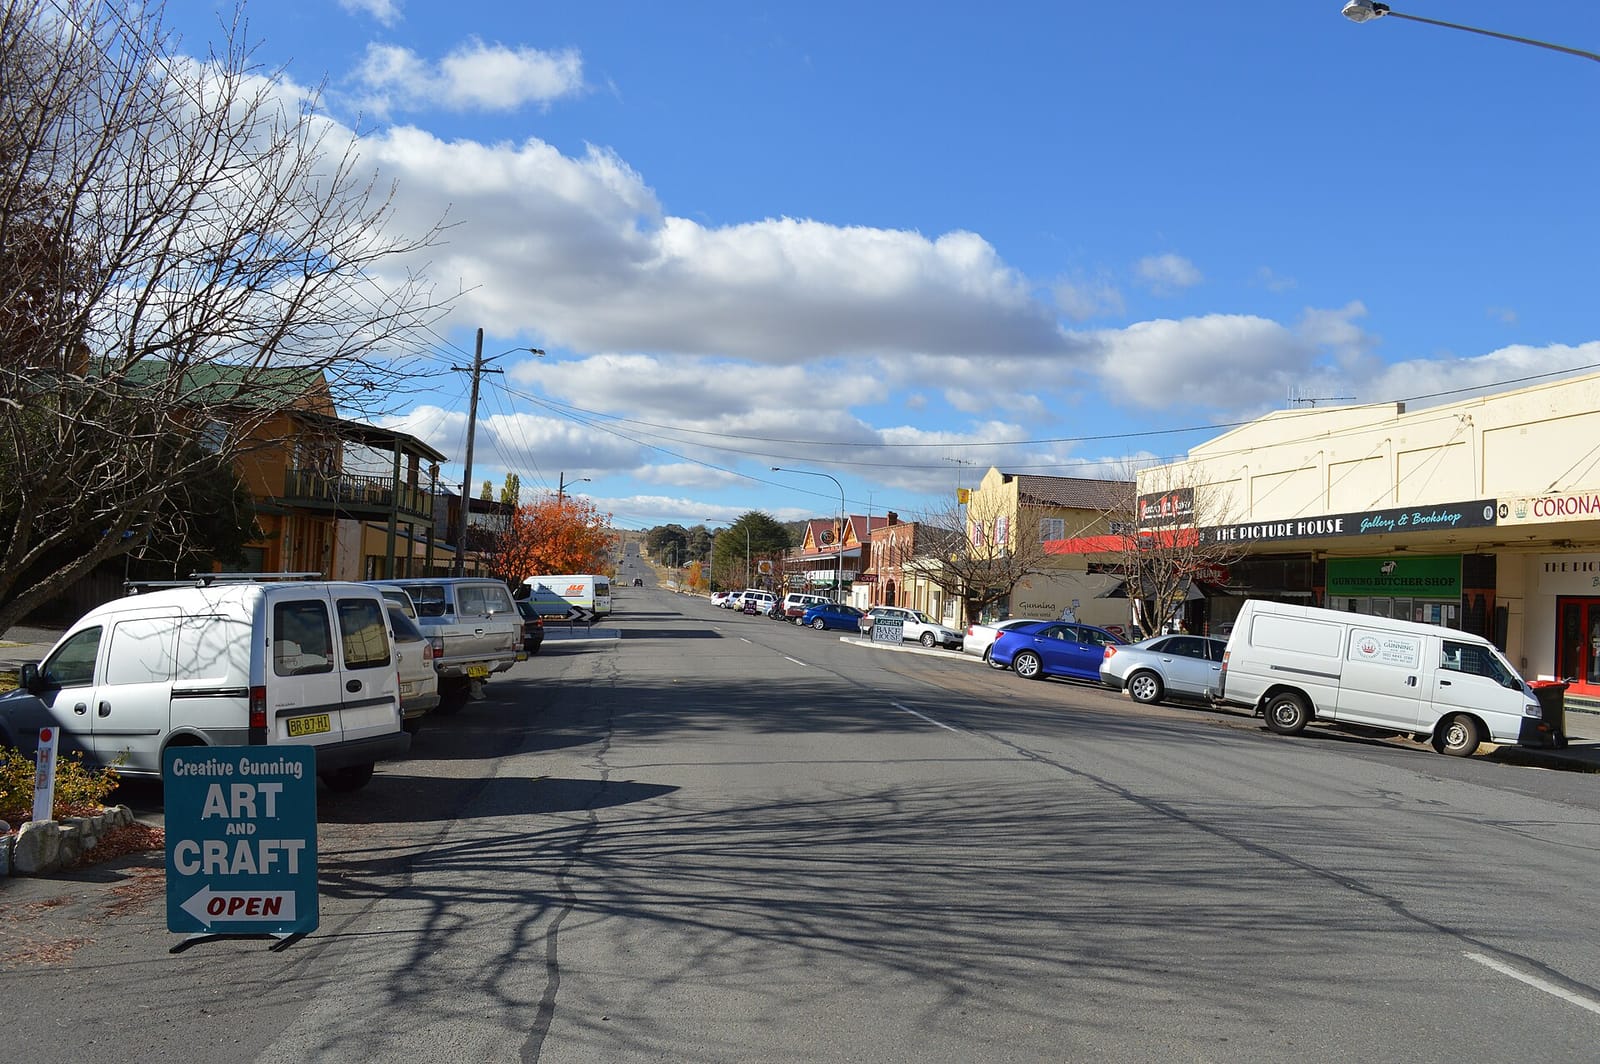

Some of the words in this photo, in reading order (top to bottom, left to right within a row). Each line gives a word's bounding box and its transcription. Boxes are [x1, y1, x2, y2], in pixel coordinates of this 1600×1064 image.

[1534, 495, 1600, 517] CORONA
[1217, 528, 1237, 540] THE
[1240, 523, 1294, 539] PICTURE
[1298, 519, 1343, 535] HOUSE
[1360, 515, 1395, 533] Gallery
[1398, 514, 1409, 526] &
[1411, 510, 1462, 525] Bookshop
[1544, 562, 1568, 572] THE
[1573, 562, 1600, 572] PIC
[1332, 577, 1373, 586] GUNNING
[1374, 577, 1423, 586] BUTCHER
[1424, 577, 1456, 586] SHOP
[1019, 602, 1056, 611] Gunning
[876, 618, 902, 626] Country
[876, 626, 900, 634] BAKE
[876, 633, 900, 641] HOUSE
[1383, 642, 1414, 651] GUNNING
[173, 758, 233, 776] Creative
[239, 757, 302, 779] Gunning
[202, 783, 283, 818] ART
[226, 822, 257, 836] AND
[174, 839, 306, 876] CRAFT
[207, 896, 283, 916] OPEN
